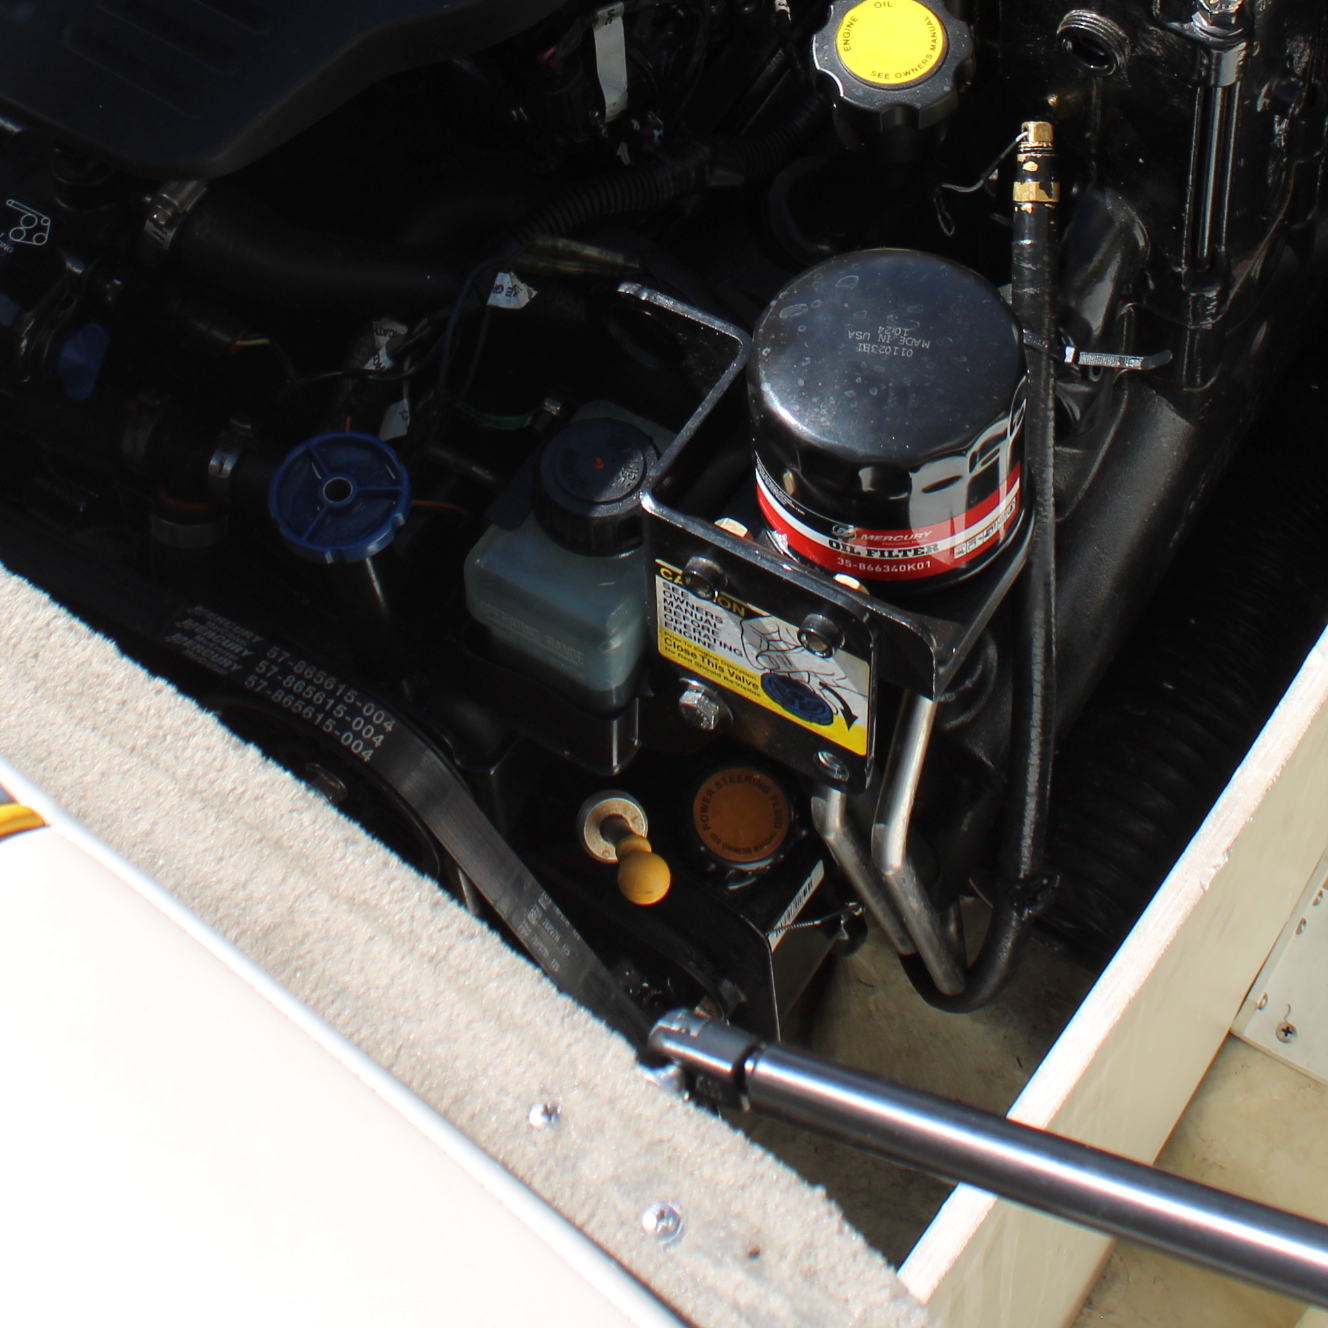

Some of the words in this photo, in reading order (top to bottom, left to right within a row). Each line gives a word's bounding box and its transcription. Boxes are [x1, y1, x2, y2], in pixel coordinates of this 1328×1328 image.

[843, 15, 859, 52] ENGINE
[873, 1, 894, 9] OIL
[870, 70, 891, 80] SEE
[895, 53, 933, 79] OWNERS
[923, 15, 938, 52] MANUAL
[847, 329, 872, 341] USA
[877, 333, 892, 344] IN
[897, 335, 931, 349] MADE
[828, 539, 863, 556] OIL
[865, 543, 940, 559] FILTER
[860, 530, 933, 542] MERCURY
[837, 557, 932, 573] 35-866340K01
[660, 567, 745, 617] CAON
[662, 581, 689, 601] SEE
[663, 589, 724, 625] OWNERS
[663, 597, 722, 631] MANUAL
[663, 605, 721, 639] BEFORE
[663, 612, 743, 658] OPERATING
[664, 621, 716, 652] ENGINE
[664, 636, 698, 660] Close
[700, 654, 725, 674] This
[727, 668, 760, 691] Valve
[255, 659, 385, 749] 57-865615-004
[266, 645, 397, 734] 57-865615-004
[244, 674, 374, 763] 57-865615-004
[700, 788, 715, 831] POWER
[714, 774, 771, 794] STEERING
